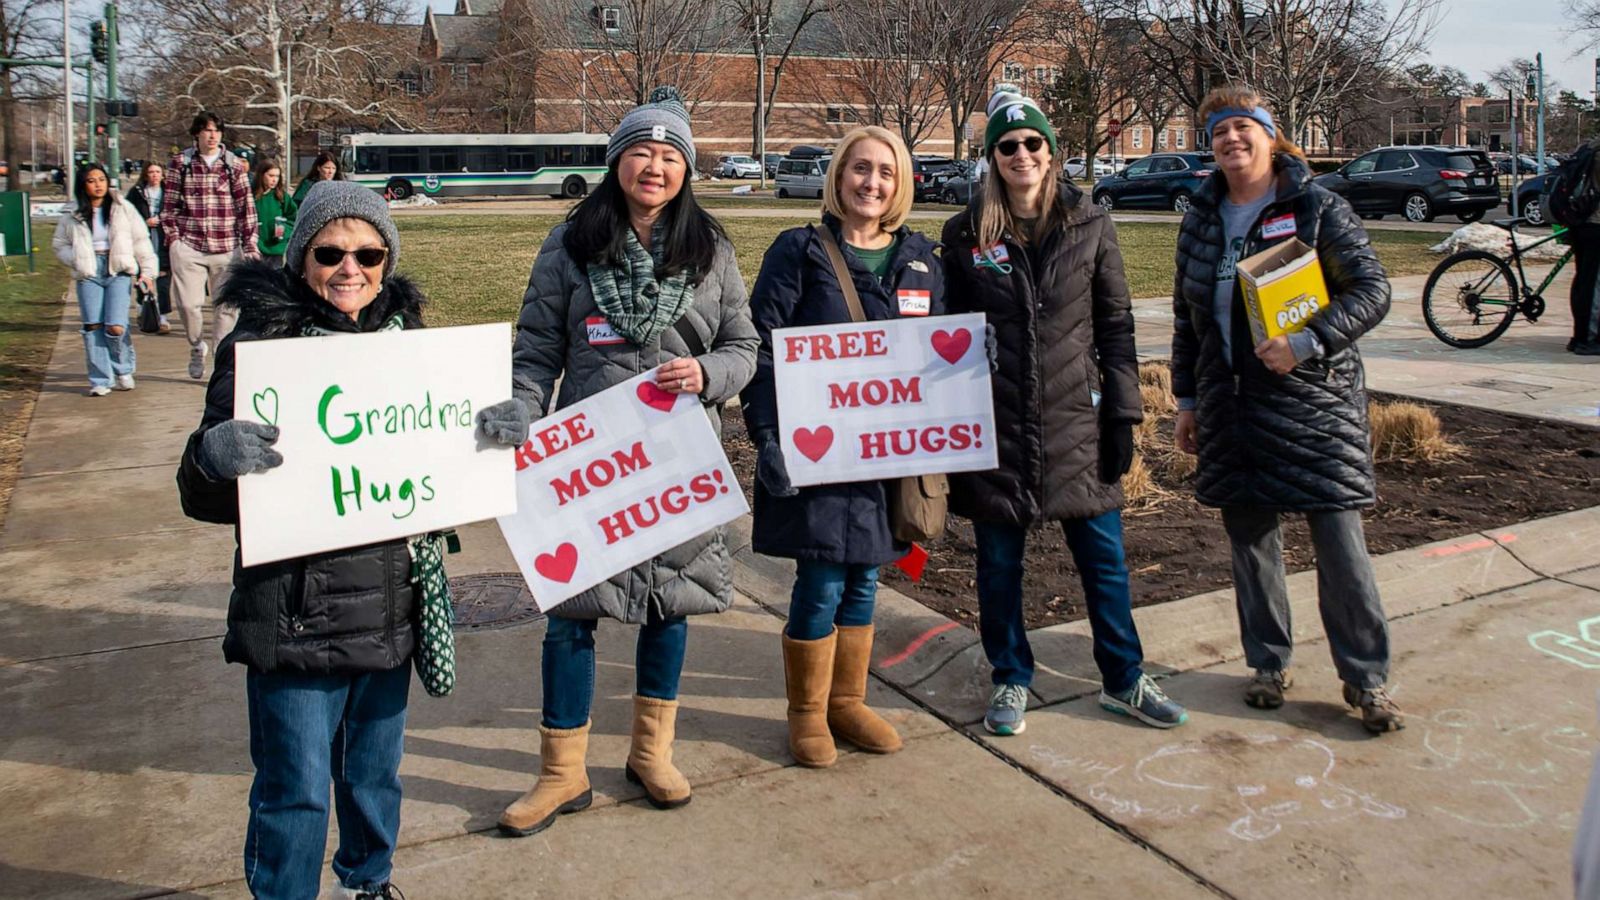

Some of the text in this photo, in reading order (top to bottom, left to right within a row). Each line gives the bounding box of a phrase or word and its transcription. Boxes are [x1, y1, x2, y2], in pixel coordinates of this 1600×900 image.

[1277, 297, 1319, 329] POPS
[784, 330, 888, 363] FREE
[317, 384, 472, 445] Grandma
[828, 377, 922, 409] MOM
[514, 412, 595, 471] REE
[858, 423, 983, 459] HUGS!
[331, 465, 435, 520] Hugs
[549, 441, 652, 506] MOM
[598, 469, 729, 545] HUGS!
